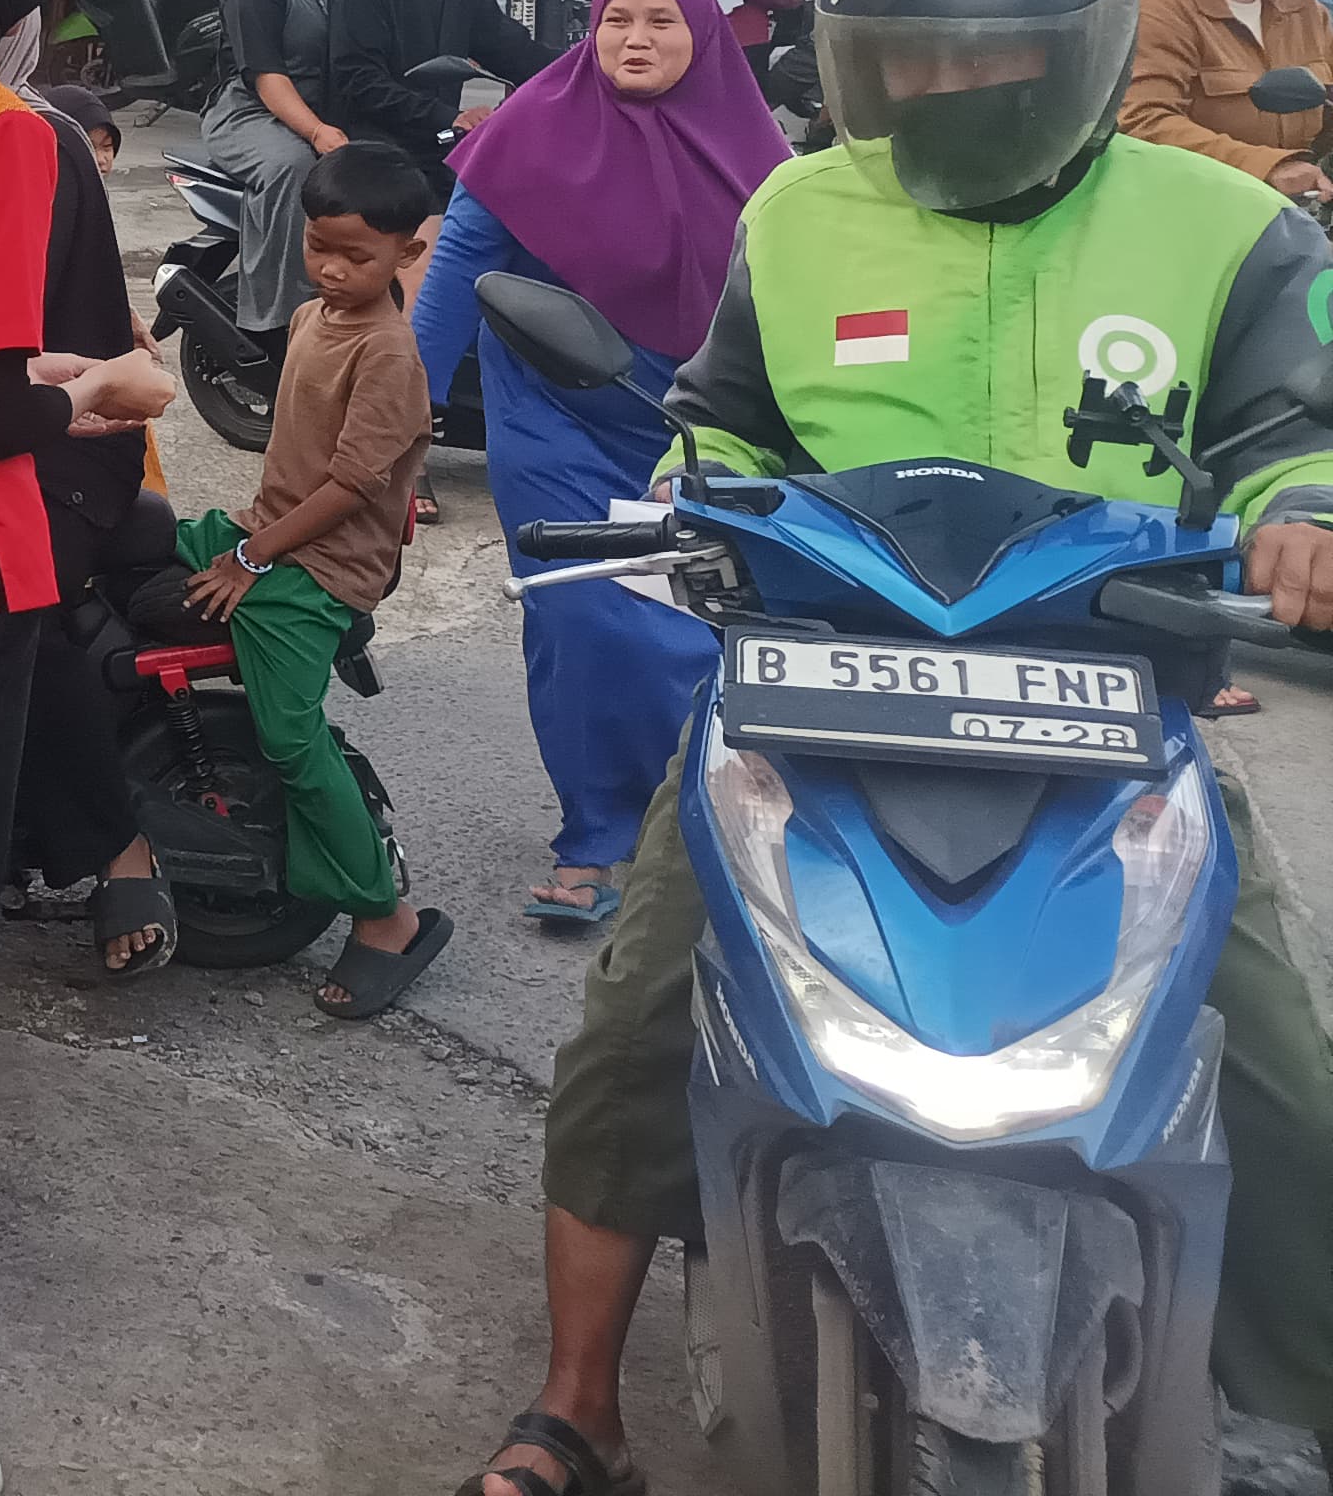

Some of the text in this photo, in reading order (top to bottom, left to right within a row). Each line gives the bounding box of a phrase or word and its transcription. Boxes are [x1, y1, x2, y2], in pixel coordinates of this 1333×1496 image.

[895, 466, 985, 481] HONDA
[757, 646, 1129, 707] B 5561 FNP
[715, 980, 759, 1081] HONDA
[1161, 1056, 1204, 1145] HONDA
